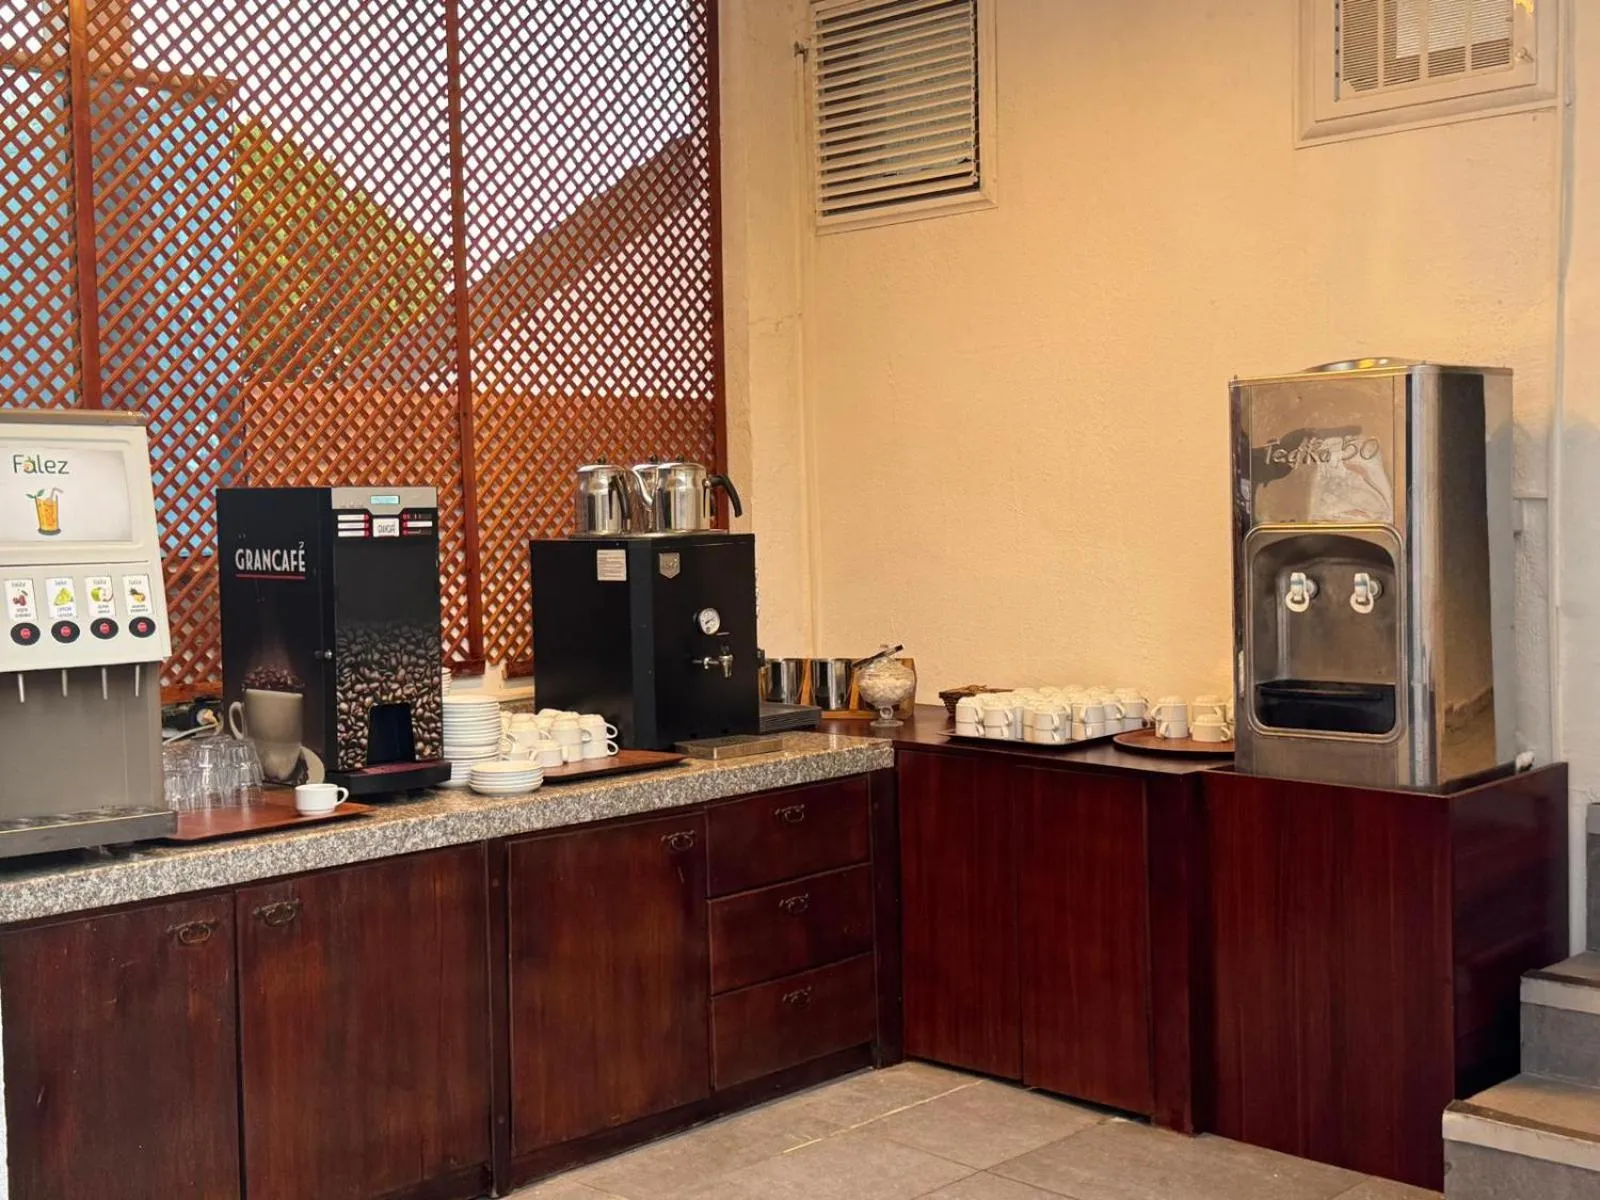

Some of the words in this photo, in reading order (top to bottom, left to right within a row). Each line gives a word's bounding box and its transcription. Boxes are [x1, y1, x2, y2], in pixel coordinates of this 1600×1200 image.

[1342, 436, 1380, 461] 50
[12, 454, 70, 475] Falez
[235, 541, 306, 572] GRANCAFÉ
